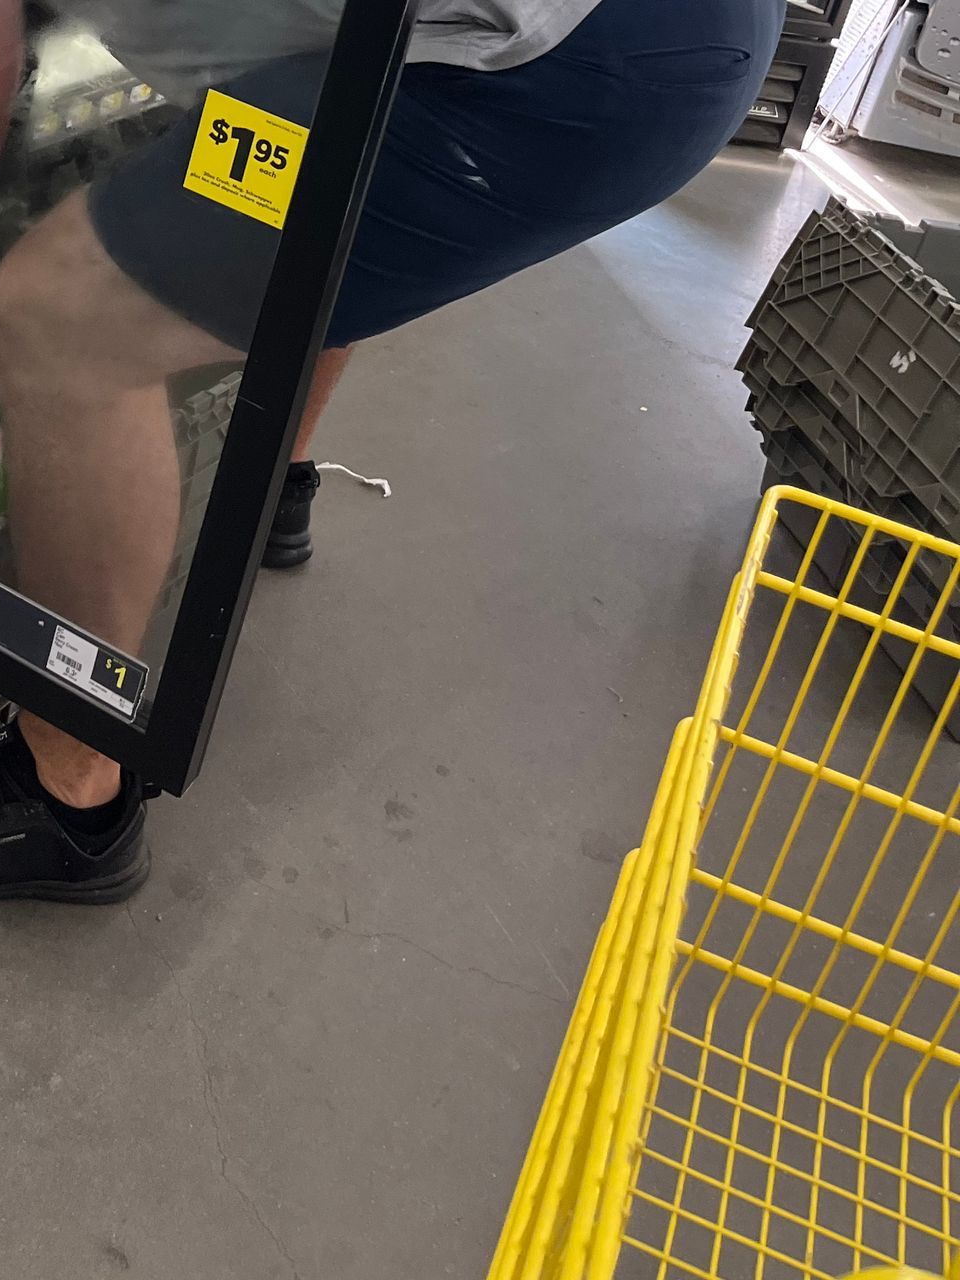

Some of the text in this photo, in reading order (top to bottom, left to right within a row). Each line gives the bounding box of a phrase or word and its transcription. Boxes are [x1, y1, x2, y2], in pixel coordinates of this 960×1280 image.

[259, 167, 277, 179] each
[210, 180, 221, 188] and
[105, 659, 127, 689] $1
